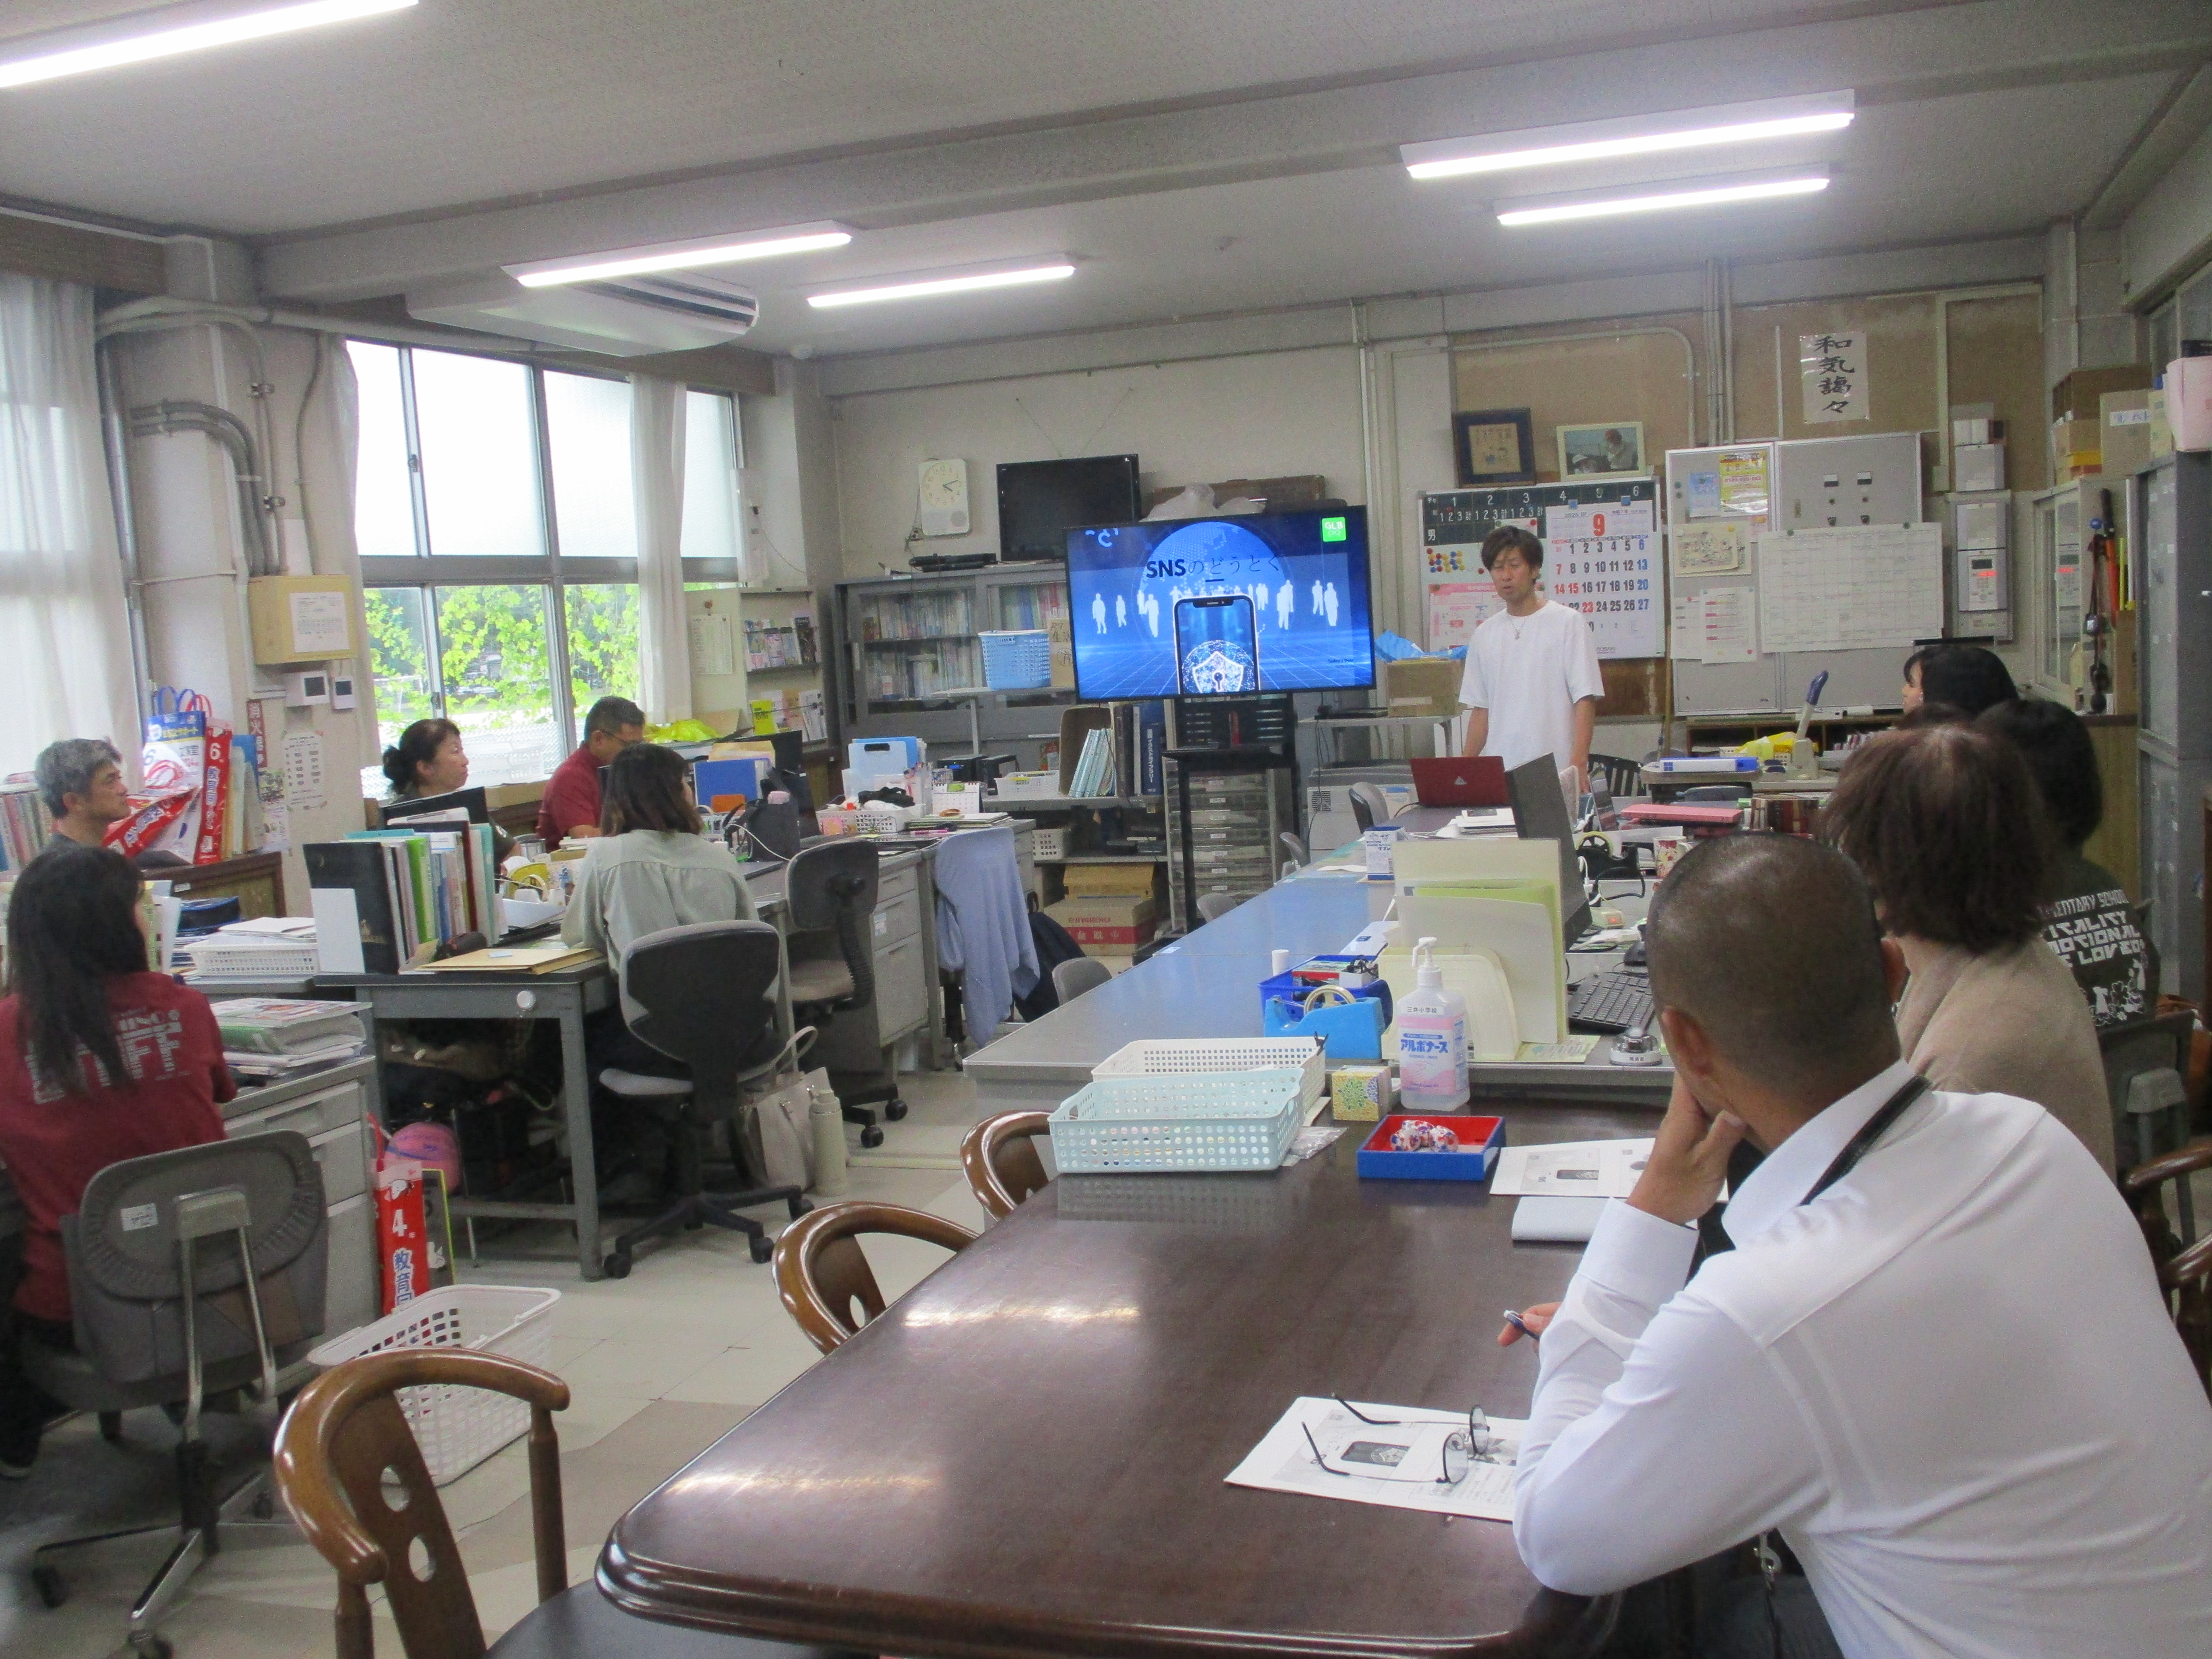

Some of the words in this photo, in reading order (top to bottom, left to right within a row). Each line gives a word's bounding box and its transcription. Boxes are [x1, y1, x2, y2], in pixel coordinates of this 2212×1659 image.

[1452, 497, 1456, 507] 1
[1487, 495, 1494, 505] 2
[1523, 492, 1530, 503] 3
[1559, 491, 1567, 501] 4
[1633, 486, 1639, 496] 6
[1440, 512, 1443, 522] 1
[1449, 512, 1453, 522] 2
[1457, 511, 1462, 521] 3
[1475, 510, 1479, 520] 1
[1483, 510, 1489, 520] 2
[1493, 509, 1498, 519] 3
[1511, 508, 1514, 518] 1
[1519, 507, 1525, 517] 2
[1528, 507, 1534, 517] 3
[1325, 521, 1344, 529] GLB
[1593, 514, 1605, 536] 9
[1428, 529, 1436, 541] 男
[1570, 543, 1574, 554] 1
[1583, 543, 1589, 553] 2
[1598, 542, 1603, 552] 3
[1611, 541, 1616, 552] 4
[1625, 540, 1631, 551] 5
[1639, 539, 1645, 550] 6
[1556, 564, 1562, 574] 7
[1570, 563, 1576, 574] 8
[1584, 562, 1589, 573] 9
[1595, 561, 1606, 572] 10
[1609, 561, 1619, 571] 11
[1623, 560, 1634, 571] 12
[1637, 559, 1648, 570] 13
[1555, 583, 1565, 594] 14
[1568, 583, 1579, 594] 15
[1582, 582, 1592, 593] 16
[1596, 581, 1607, 592] 17
[1610, 580, 1620, 591] 18
[1623, 579, 1634, 590] 19
[1637, 579, 1649, 590] 20
[1582, 602, 1594, 613] 23
[1596, 601, 1607, 612] 24
[1610, 600, 1621, 611] 25
[1624, 599, 1635, 611] 26
[1638, 599, 1649, 610] 27
[1401, 1039, 1449, 1053] アルボナース
